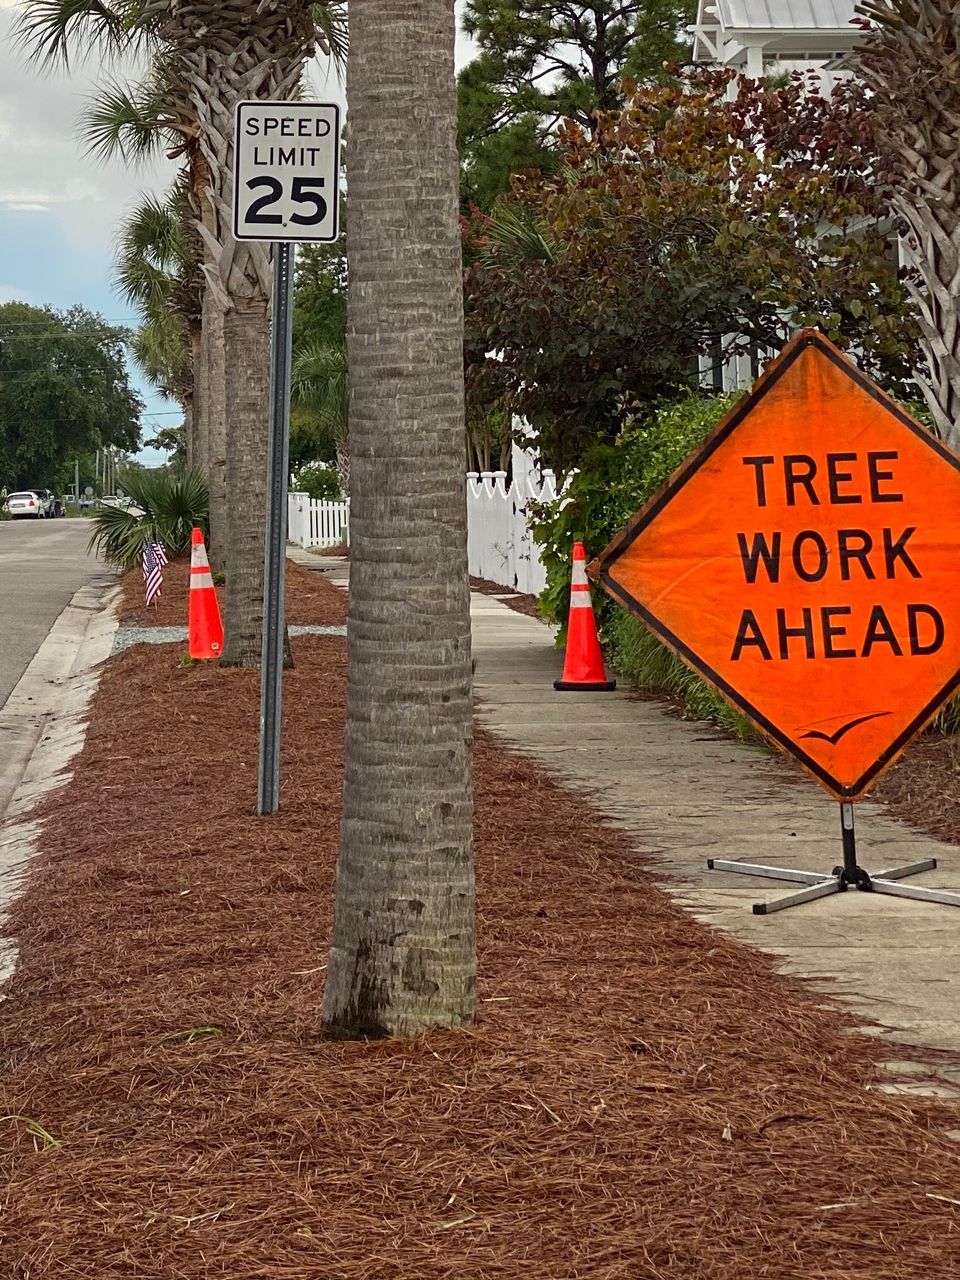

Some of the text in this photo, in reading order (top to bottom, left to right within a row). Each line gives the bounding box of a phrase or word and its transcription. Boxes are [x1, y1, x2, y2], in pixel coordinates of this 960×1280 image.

[245, 117, 331, 137] SPEED
[253, 147, 320, 166] LIMIT
[244, 175, 328, 225] 25
[742, 450, 904, 507] TREE
[736, 526, 923, 584] WORK
[729, 603, 945, 661] AHEAD
